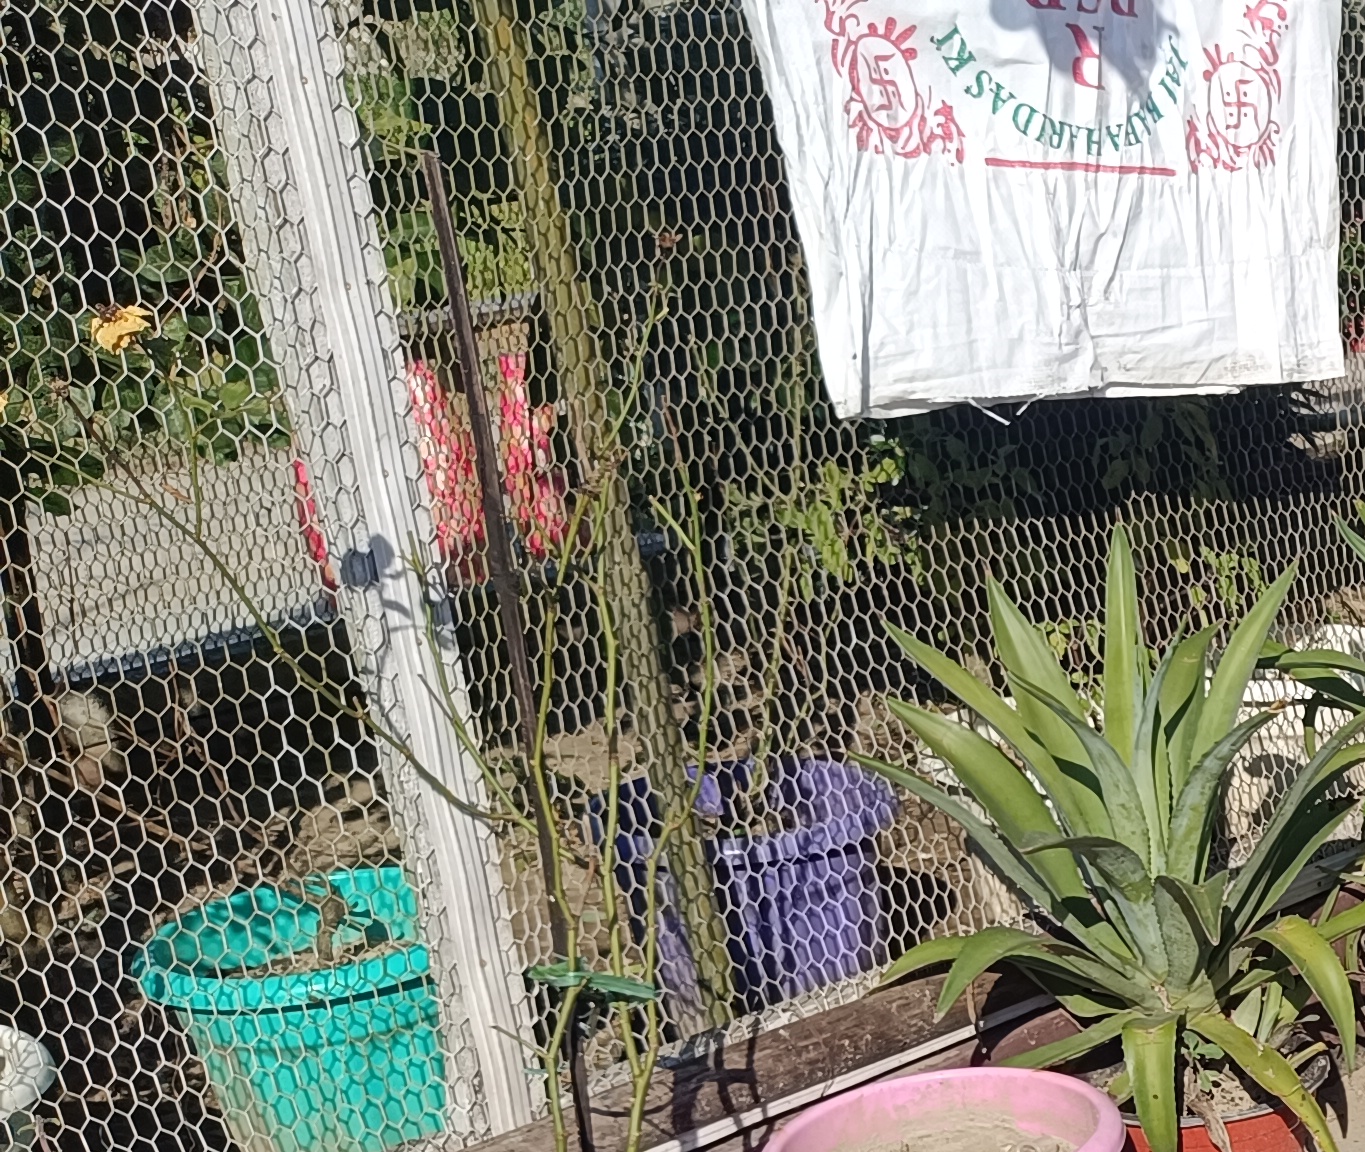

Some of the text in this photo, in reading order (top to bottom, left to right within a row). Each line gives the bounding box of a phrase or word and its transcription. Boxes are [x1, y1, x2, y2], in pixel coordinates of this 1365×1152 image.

[929, 24, 977, 77] KI
[1065, 22, 1105, 91] R
[1158, 35, 1189, 104] JAI
